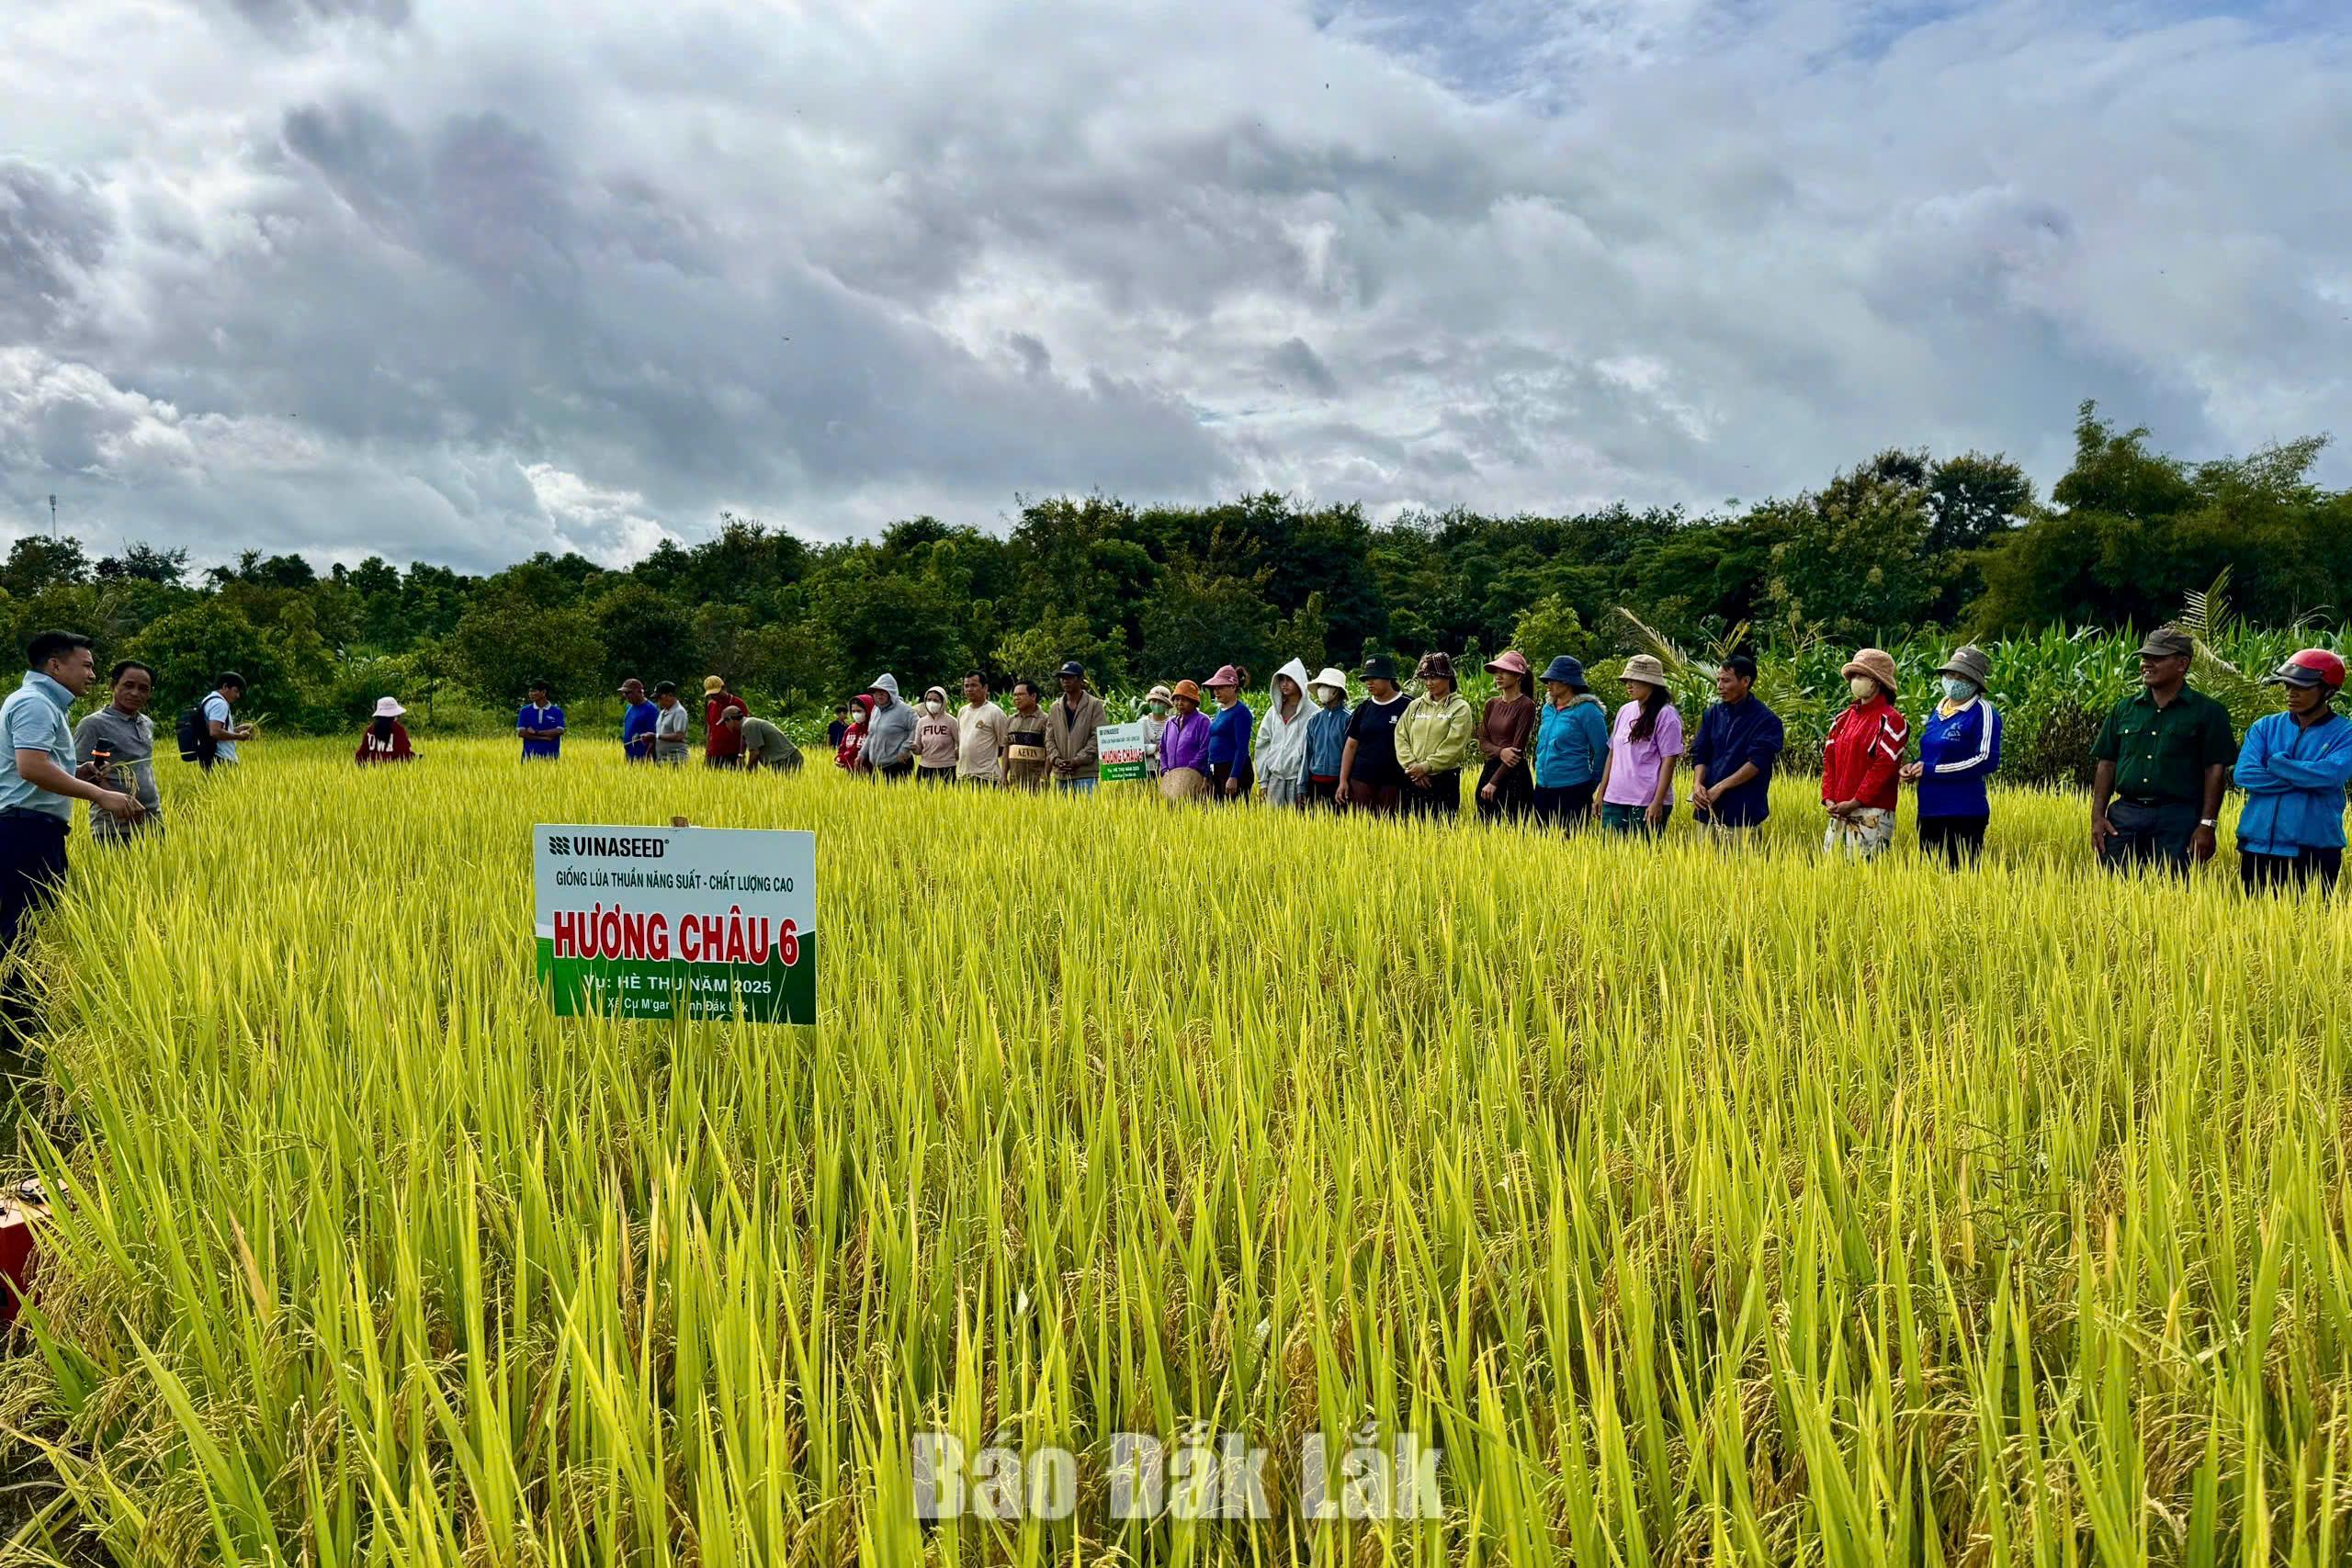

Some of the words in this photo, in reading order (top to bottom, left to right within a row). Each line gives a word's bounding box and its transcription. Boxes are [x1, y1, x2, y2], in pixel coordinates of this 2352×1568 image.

[556, 865, 587, 886] GIỐNG
[590, 868, 609, 887] LÚA
[611, 867, 644, 888] THUẦN
[646, 870, 673, 889] NĂNG
[675, 869, 701, 889] SUẤT
[709, 869, 735, 891] CHẤT
[738, 874, 771, 894] LƯỢNG
[774, 877, 794, 893] CAO
[552, 901, 671, 962] HƯƠNG
[679, 905, 770, 965] CHÂU
[778, 919, 800, 966] 6
[617, 972, 641, 989] HÈ
[647, 976, 683, 991] THU
[690, 975, 727, 992] NĂM
[733, 980, 772, 994] 2025
[641, 998, 670, 1012] M'gar
